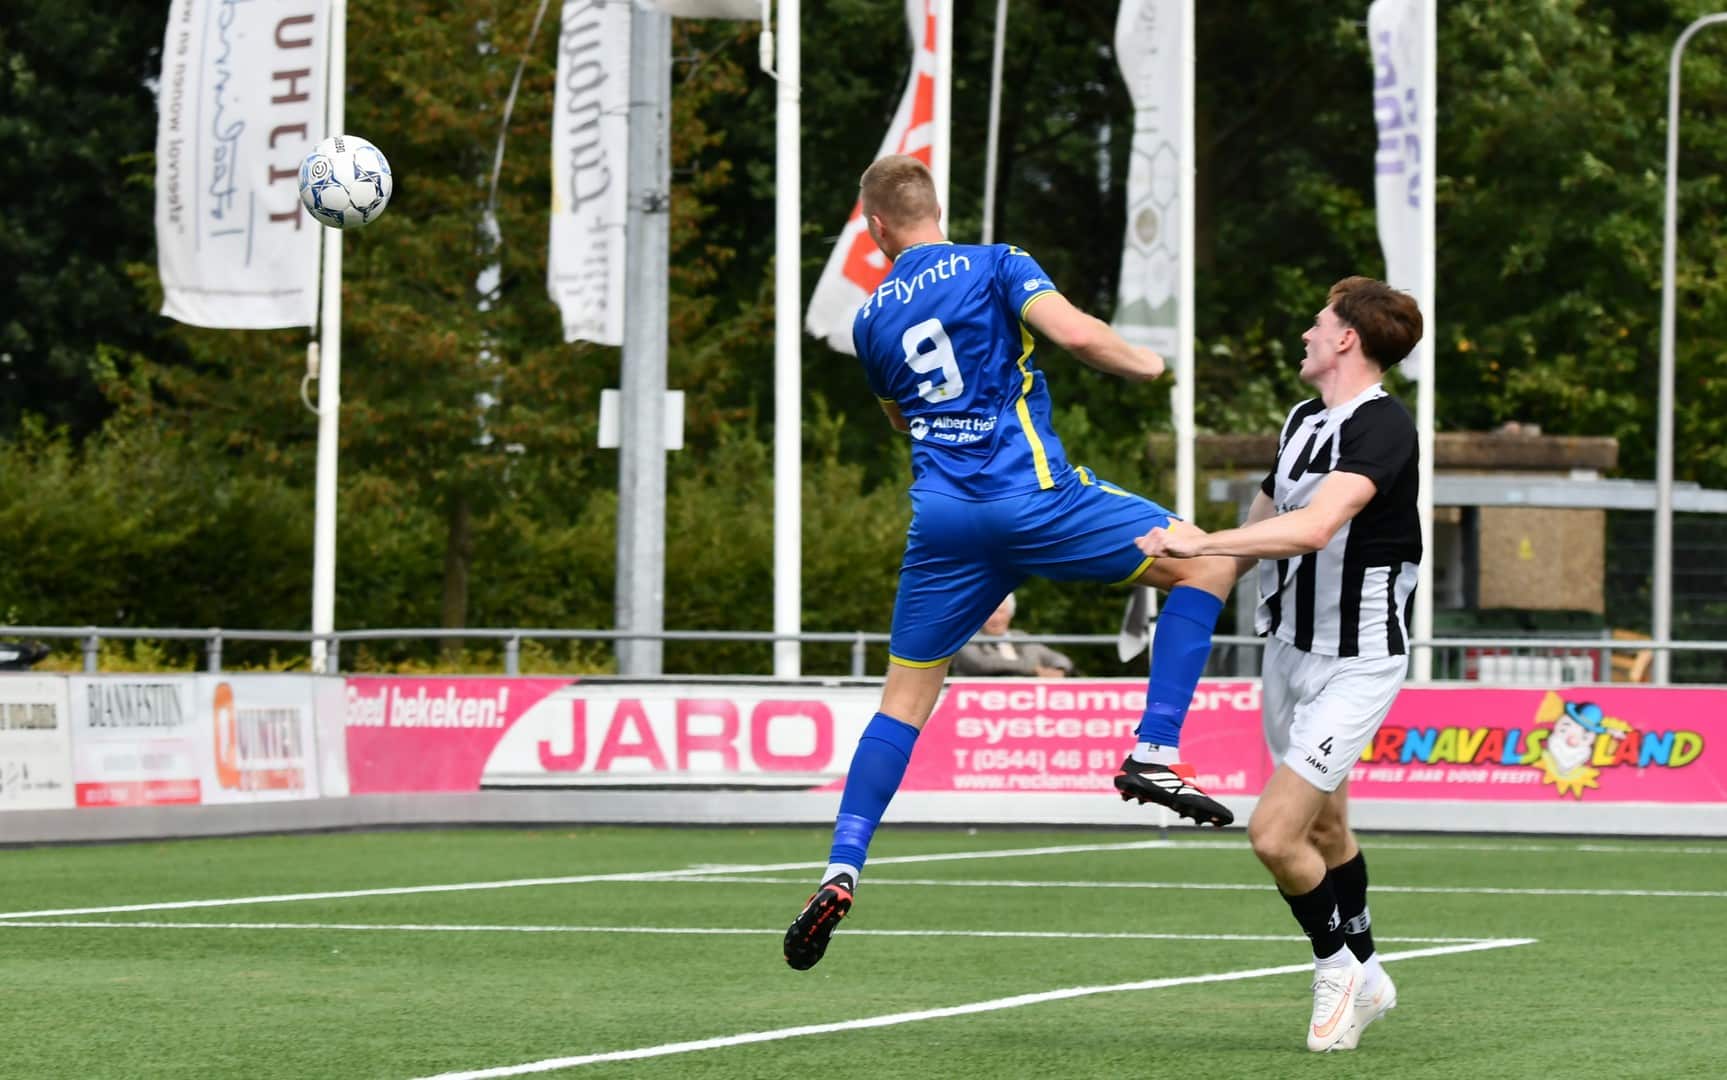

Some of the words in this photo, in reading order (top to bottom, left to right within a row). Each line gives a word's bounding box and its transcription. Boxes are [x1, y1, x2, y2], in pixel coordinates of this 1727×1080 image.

[877, 253, 970, 307] Flynth
[902, 318, 964, 403] 9
[932, 416, 973, 430] Albert
[346, 685, 388, 727] Goed
[393, 686, 508, 729] bekeken!
[957, 685, 1260, 711] reclameord
[538, 698, 834, 773] JARO
[1318, 735, 1334, 757] 4
[1305, 755, 1328, 775] JAKO
